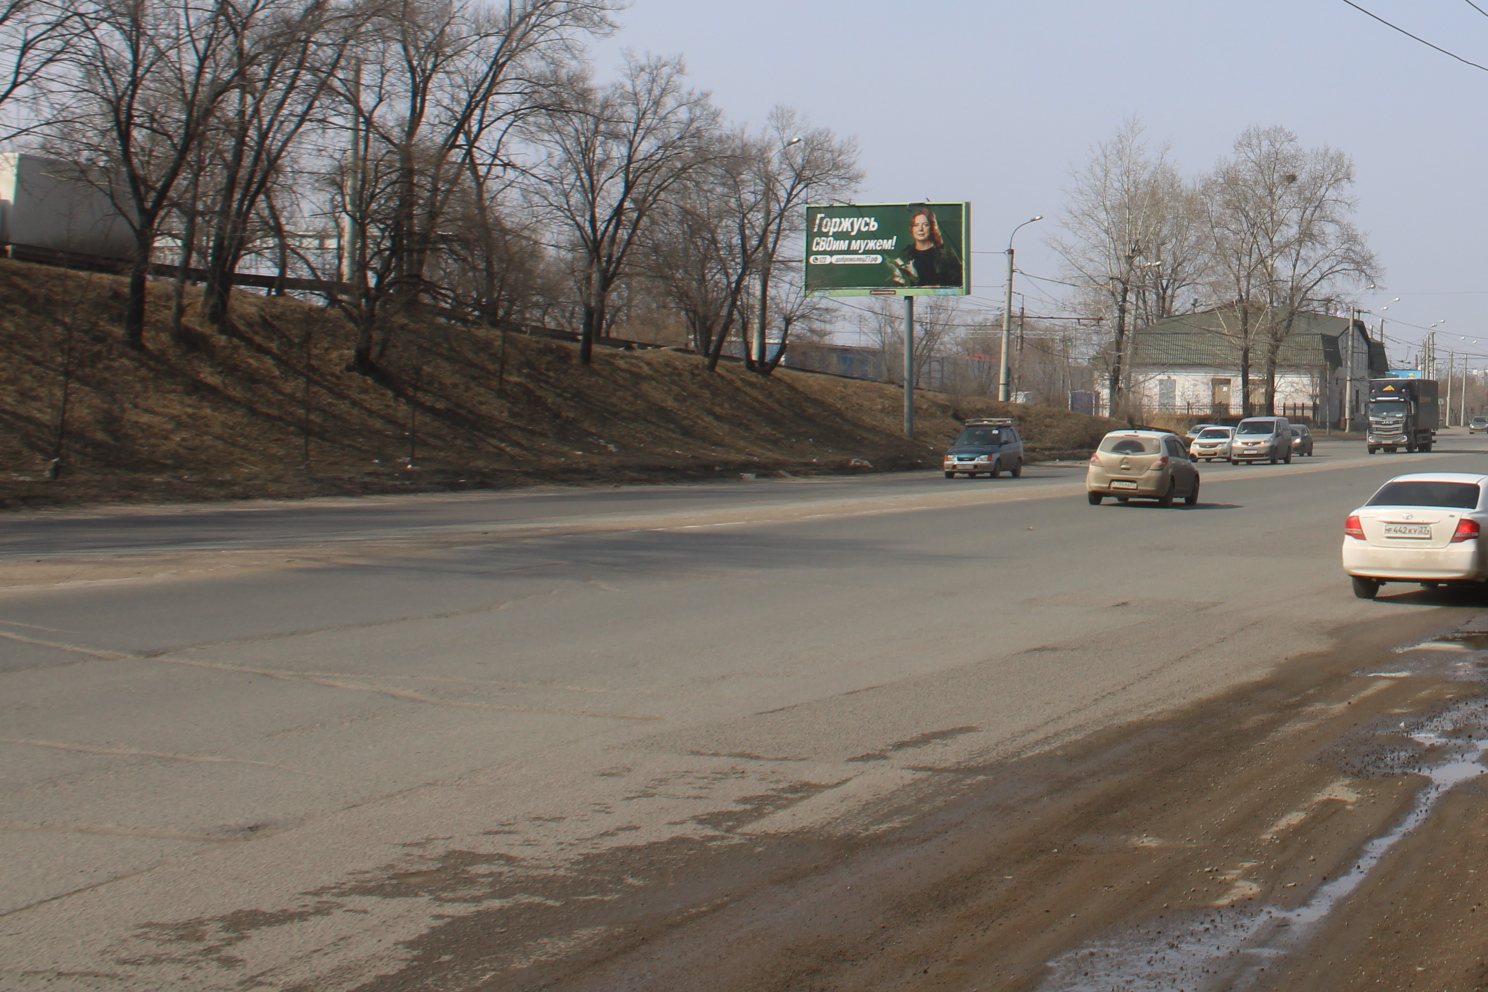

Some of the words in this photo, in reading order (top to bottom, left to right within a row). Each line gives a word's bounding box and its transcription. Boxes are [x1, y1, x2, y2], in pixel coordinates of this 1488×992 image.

[813, 213, 879, 236] Горжусь
[812, 237, 850, 251] СВОим
[850, 236, 897, 253] мужем!
